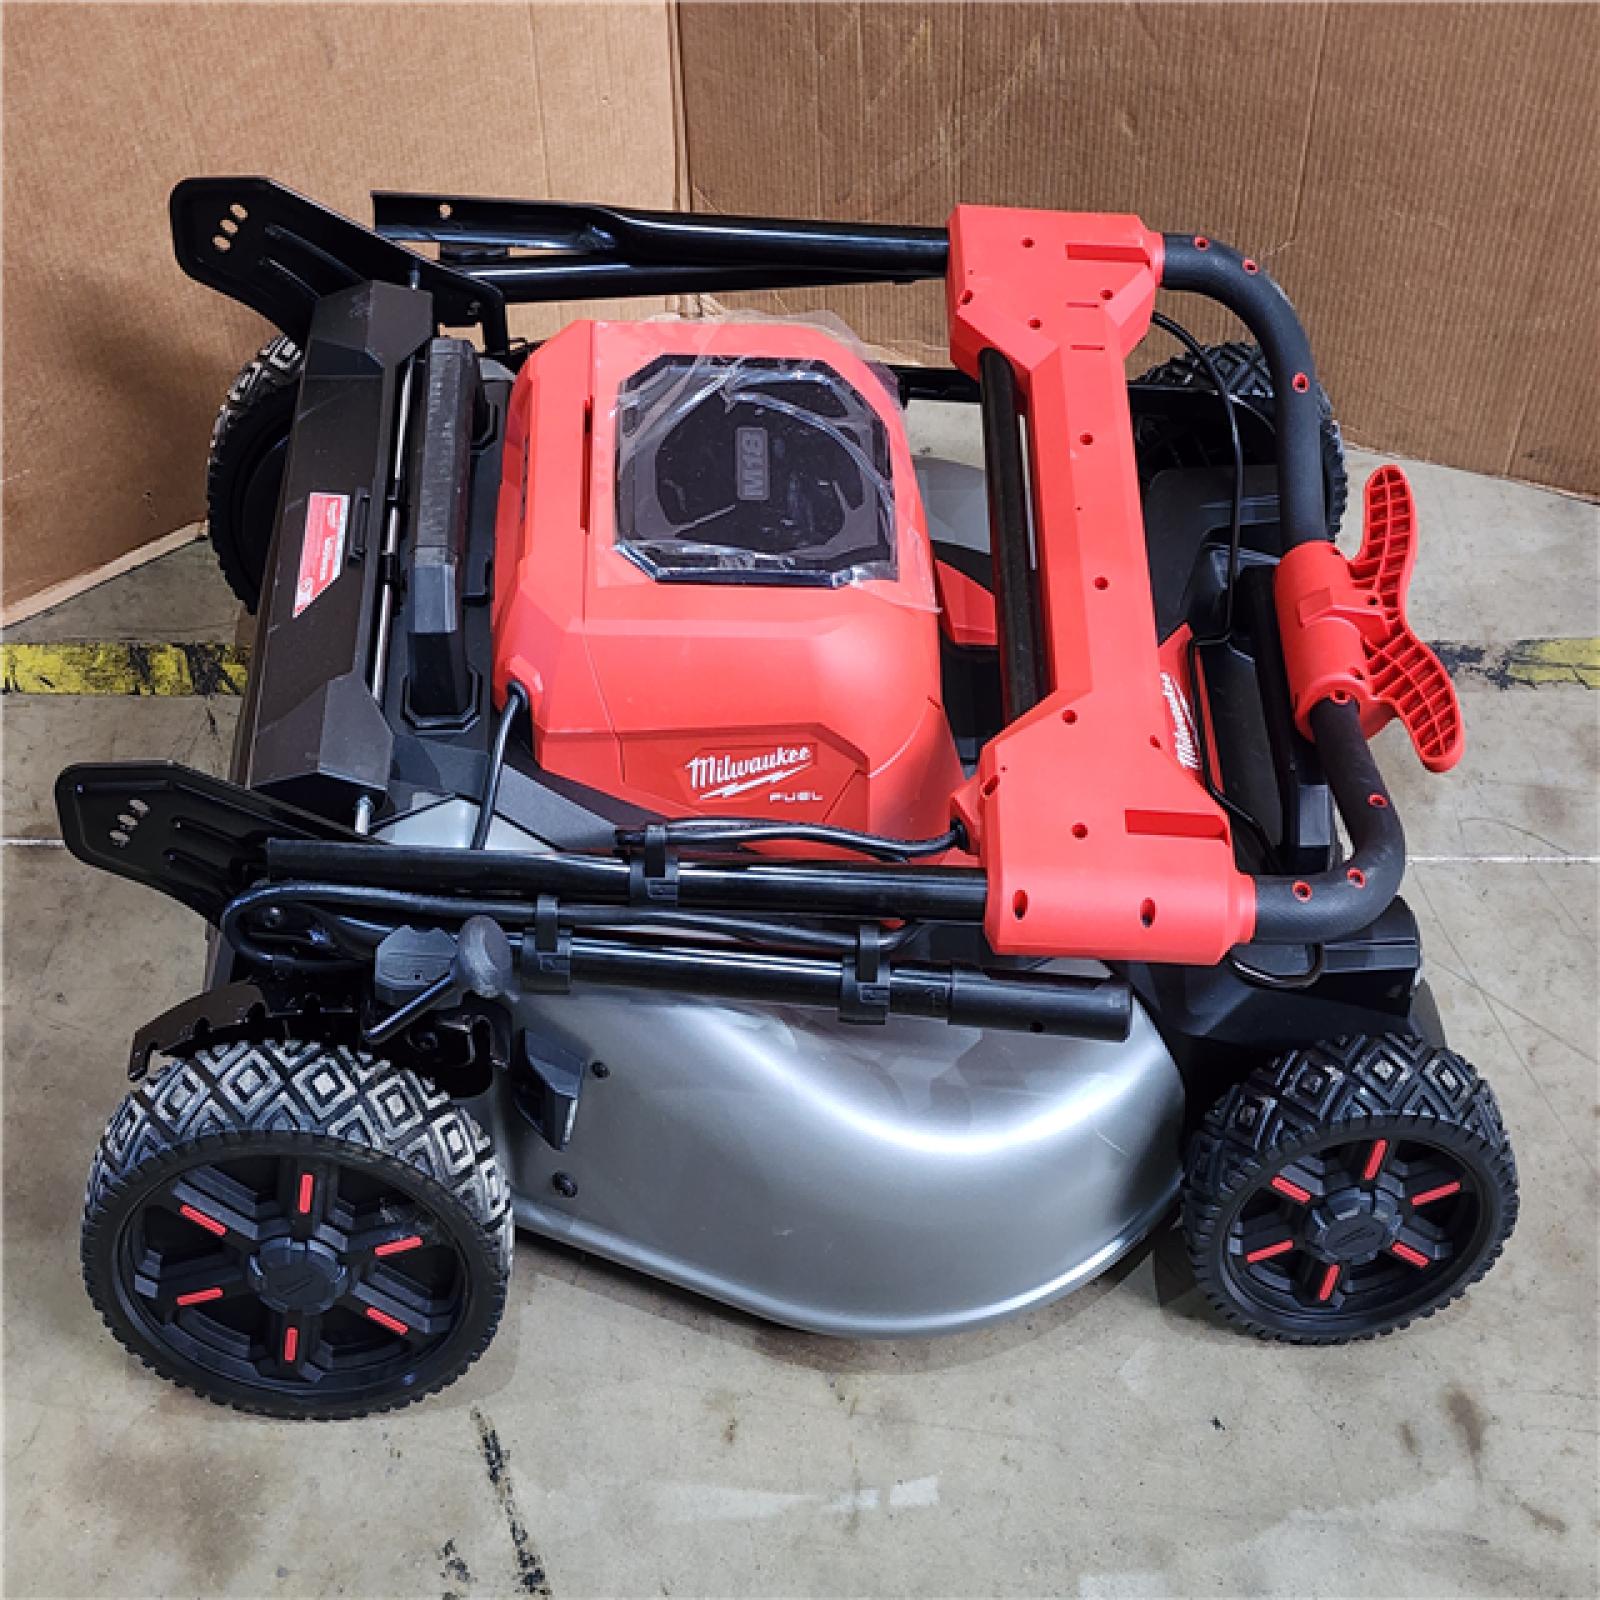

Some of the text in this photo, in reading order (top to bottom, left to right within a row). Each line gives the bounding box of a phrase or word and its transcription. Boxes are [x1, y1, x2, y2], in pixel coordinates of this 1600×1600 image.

[741, 431, 764, 497] M18
[686, 746, 811, 789] Milwaukee
[769, 791, 823, 802] FUEL
